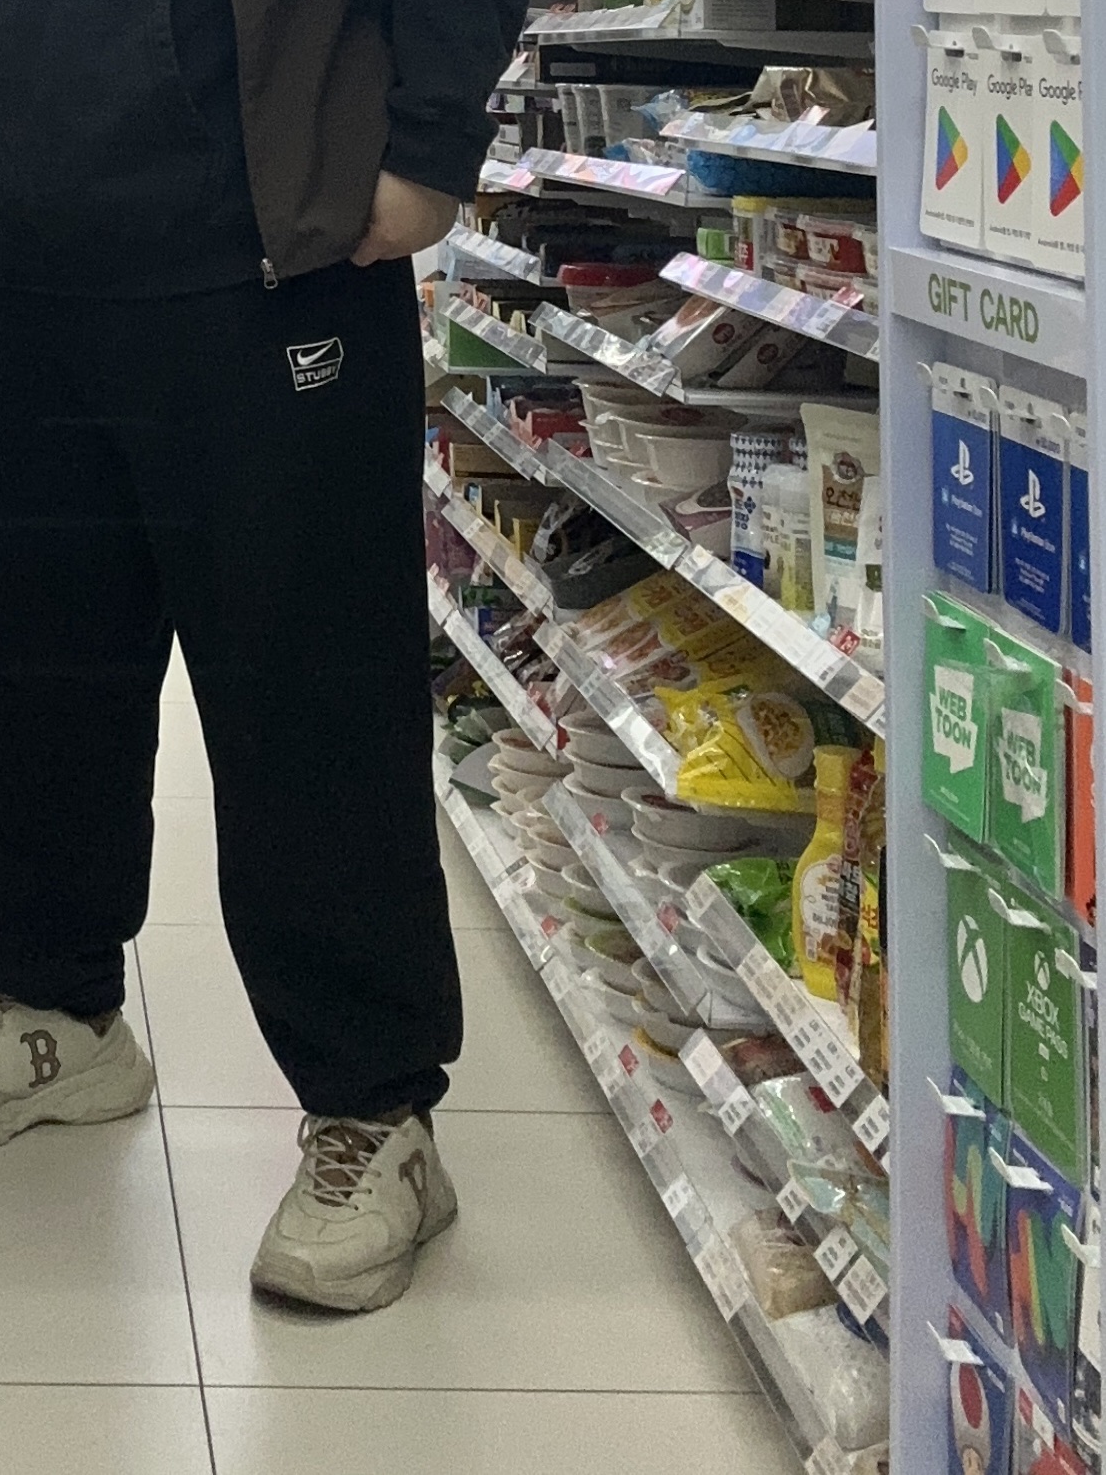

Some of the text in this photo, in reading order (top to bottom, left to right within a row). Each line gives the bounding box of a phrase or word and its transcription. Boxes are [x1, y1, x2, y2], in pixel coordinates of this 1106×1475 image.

[931, 67, 978, 96] Google Play
[987, 74, 1018, 101] Google
[1038, 78, 1077, 105] Google
[928, 272, 1040, 345] GIFT CARD
[937, 687, 968, 722] WEB
[935, 706, 972, 750] TOON
[1026, 980, 1060, 1030] XBOX
[20, 1029, 63, 1089] B
